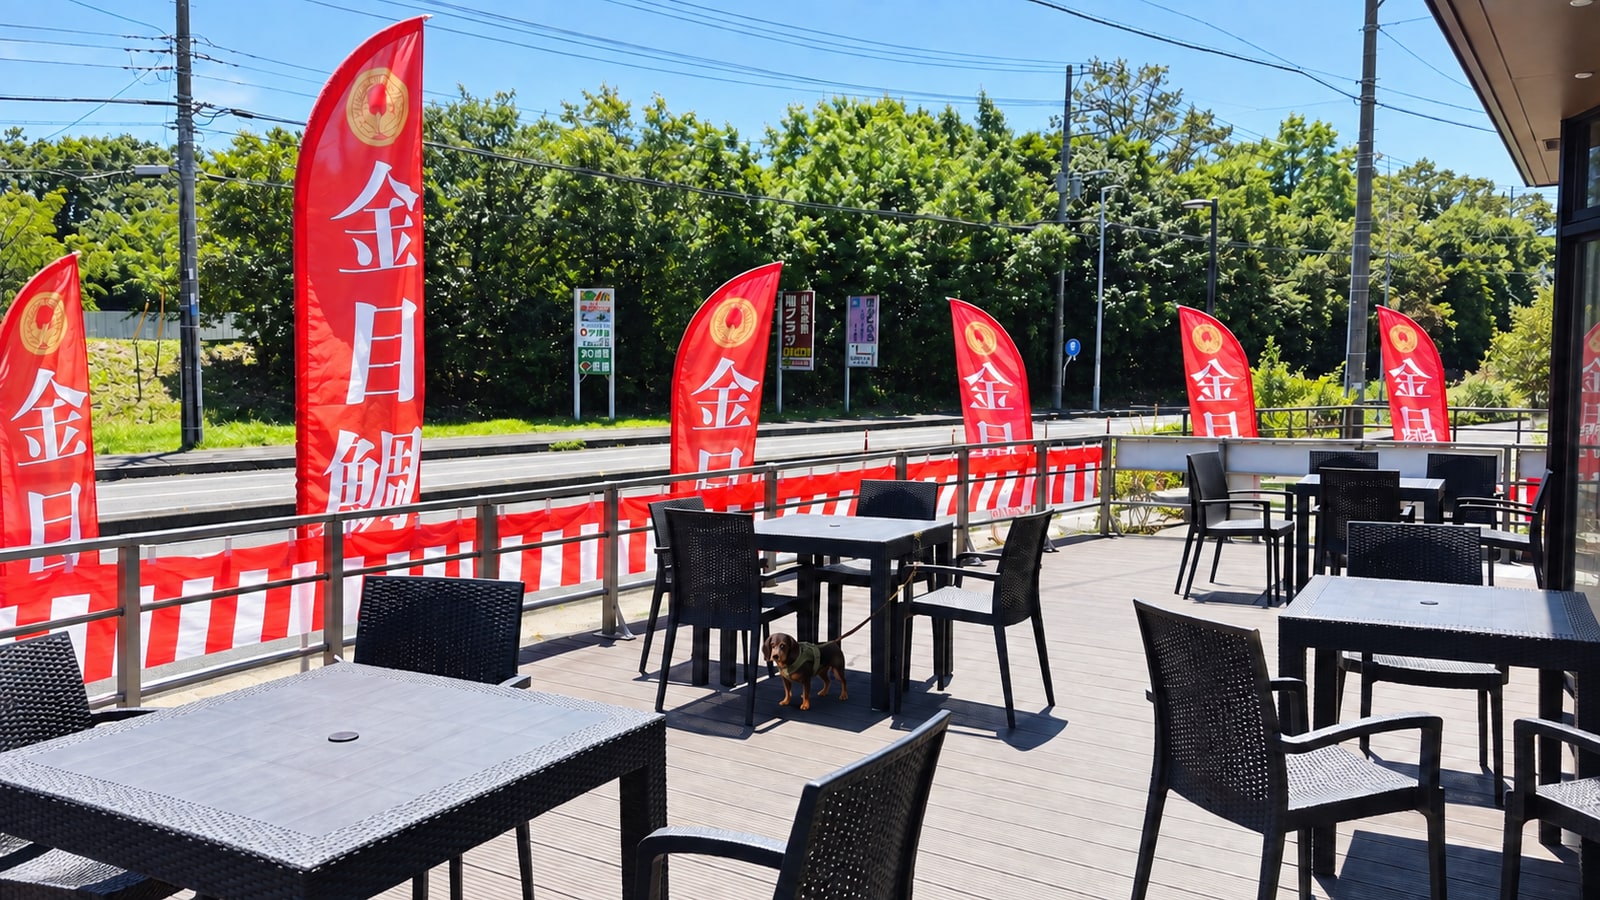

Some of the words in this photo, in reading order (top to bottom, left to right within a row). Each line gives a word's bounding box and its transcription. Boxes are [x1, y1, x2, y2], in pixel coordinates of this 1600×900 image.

[11, 367, 89, 574] 金目
[323, 160, 422, 533] 金目鯛
